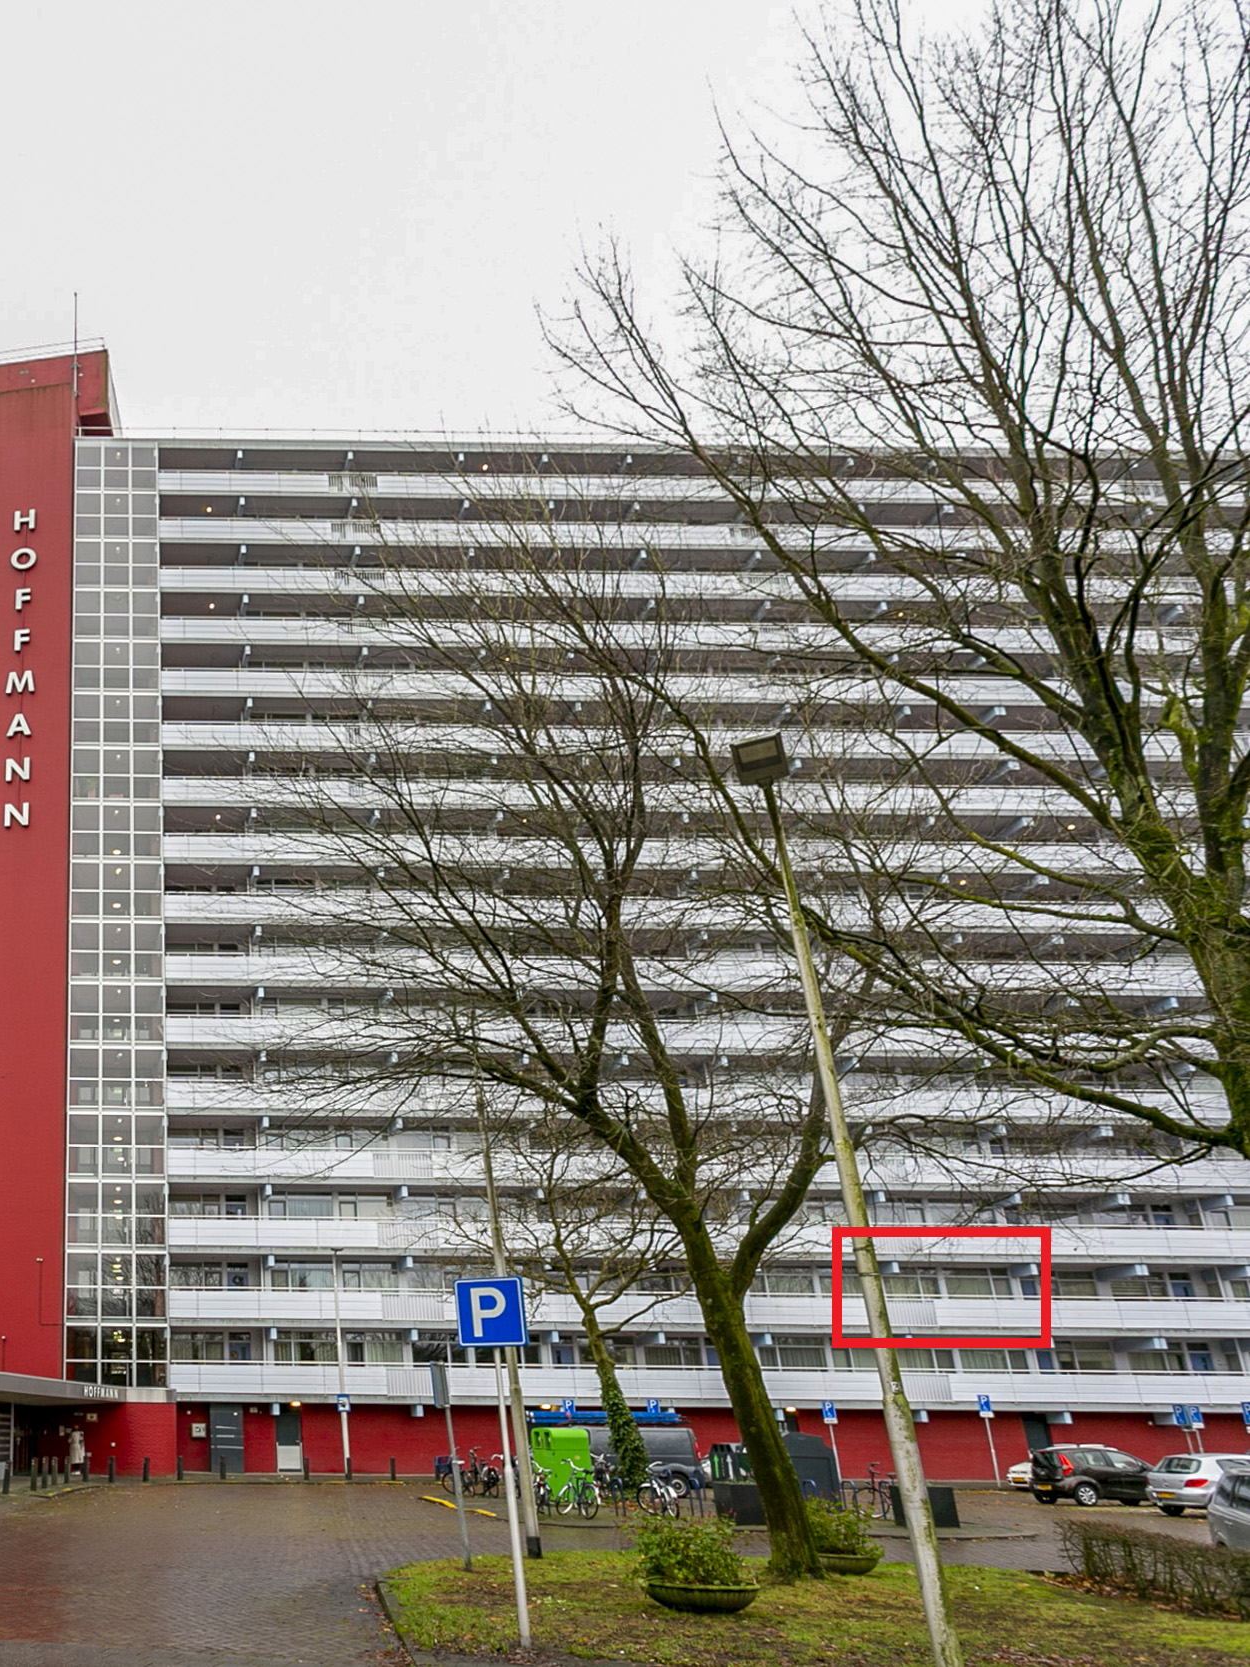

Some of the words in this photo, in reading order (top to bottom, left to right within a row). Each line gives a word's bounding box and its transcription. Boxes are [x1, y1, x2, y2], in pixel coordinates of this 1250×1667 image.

[3, 508, 37, 827] HOFFMANN
[470, 1286, 506, 1338] P
[83, 1385, 119, 1399] HOFFMANN
[565, 1399, 573, 1409] P
[650, 1399, 657, 1409] P
[980, 1395, 988, 1405] P
[825, 1401, 832, 1411] P
[1174, 1405, 1182, 1416] P
[1189, 1406, 1198, 1416] P
